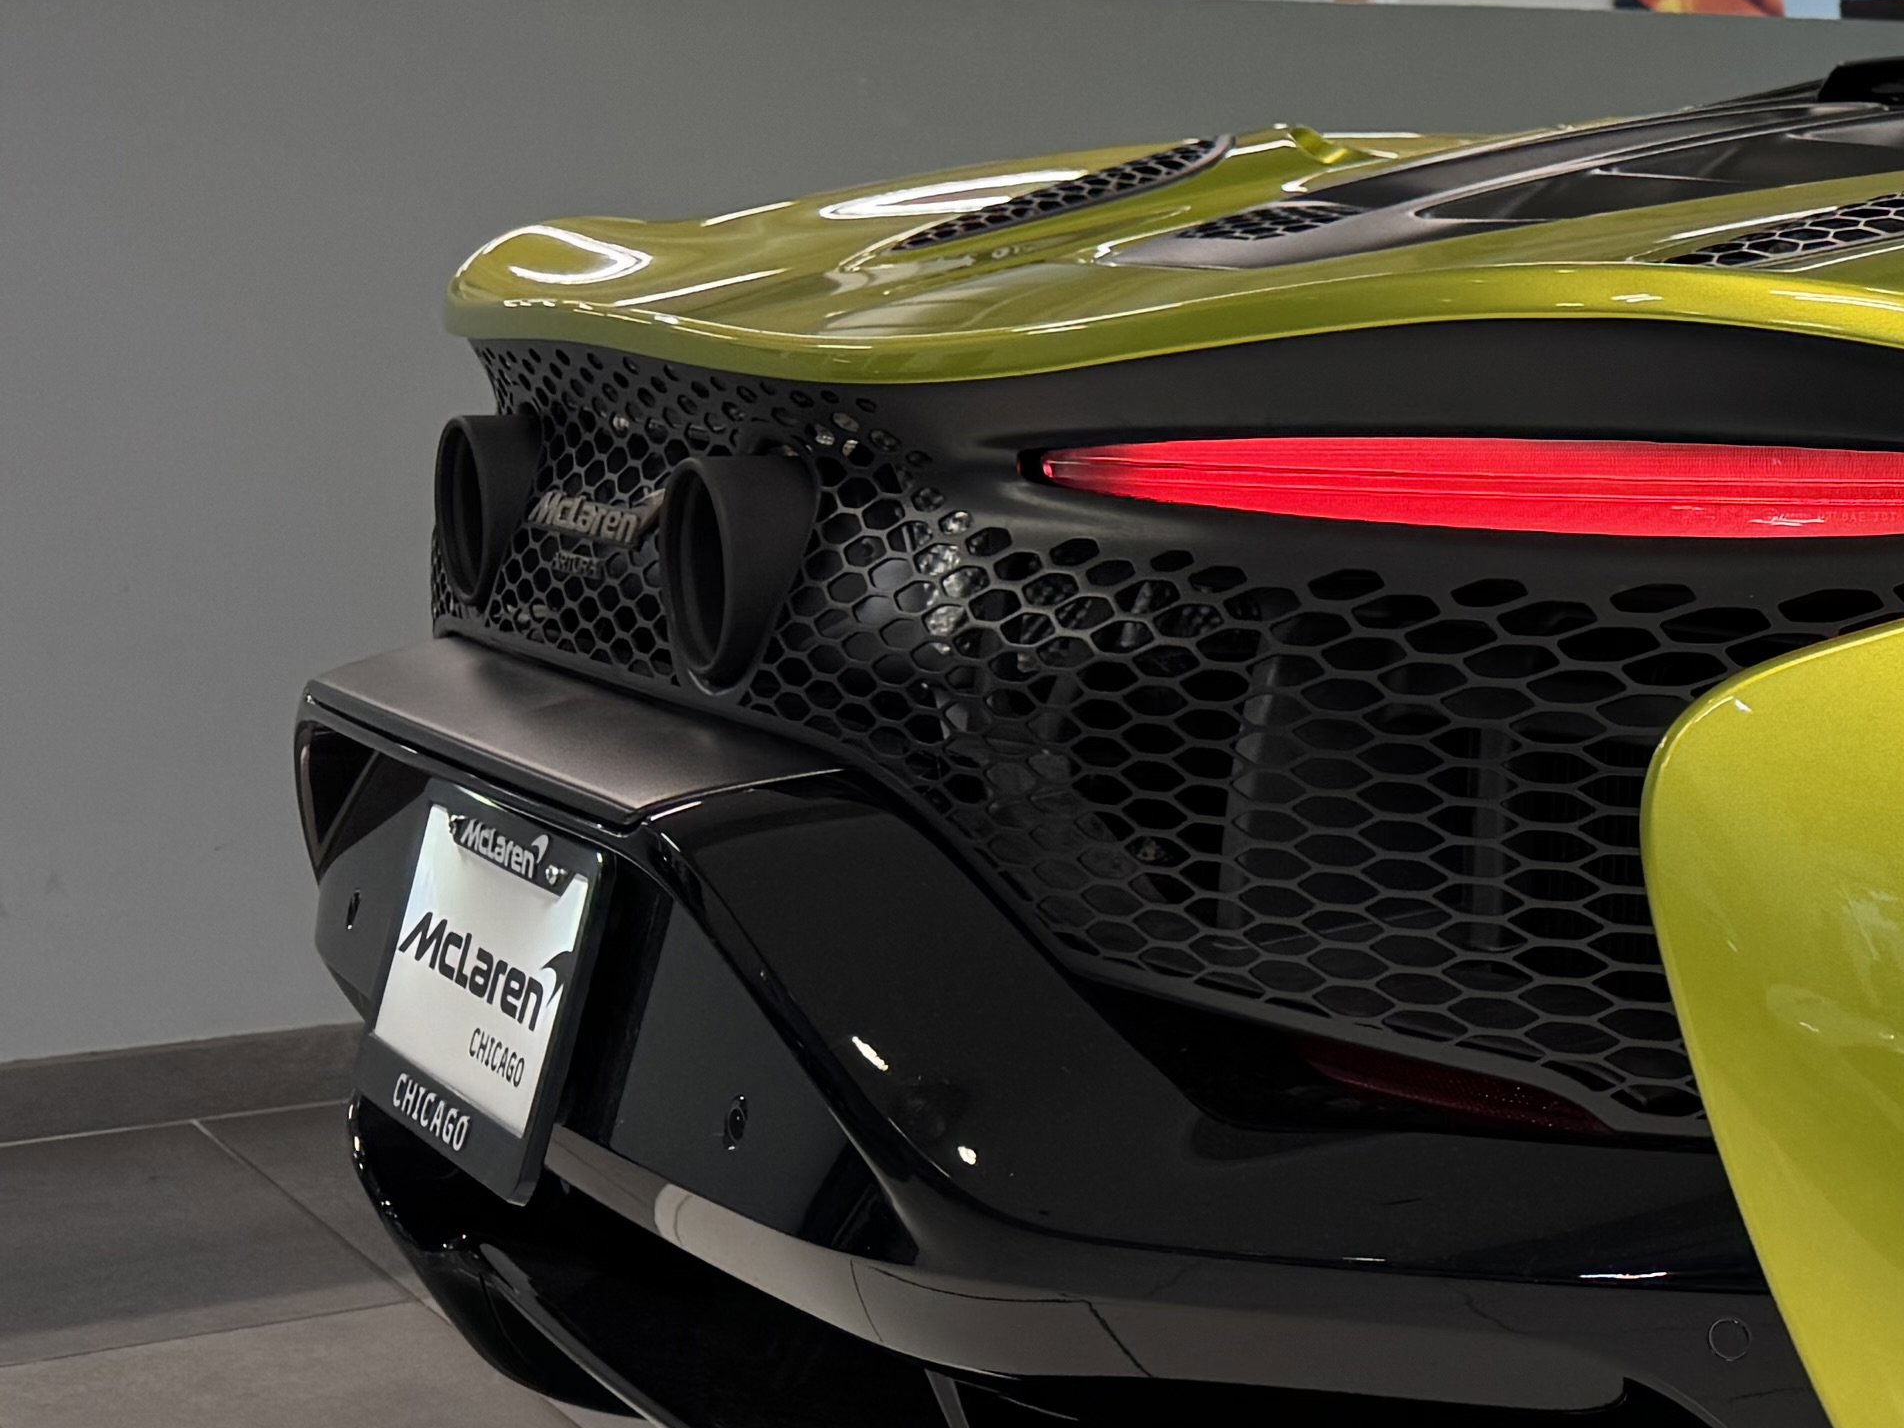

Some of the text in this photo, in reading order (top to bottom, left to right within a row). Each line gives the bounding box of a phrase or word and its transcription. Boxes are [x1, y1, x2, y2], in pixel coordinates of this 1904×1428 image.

[528, 490, 639, 545] McLaren
[460, 817, 536, 879] McLaren
[398, 911, 545, 1031] McLaren
[468, 1027, 525, 1088] CHICAGO
[392, 1072, 472, 1152] CHICAGO
